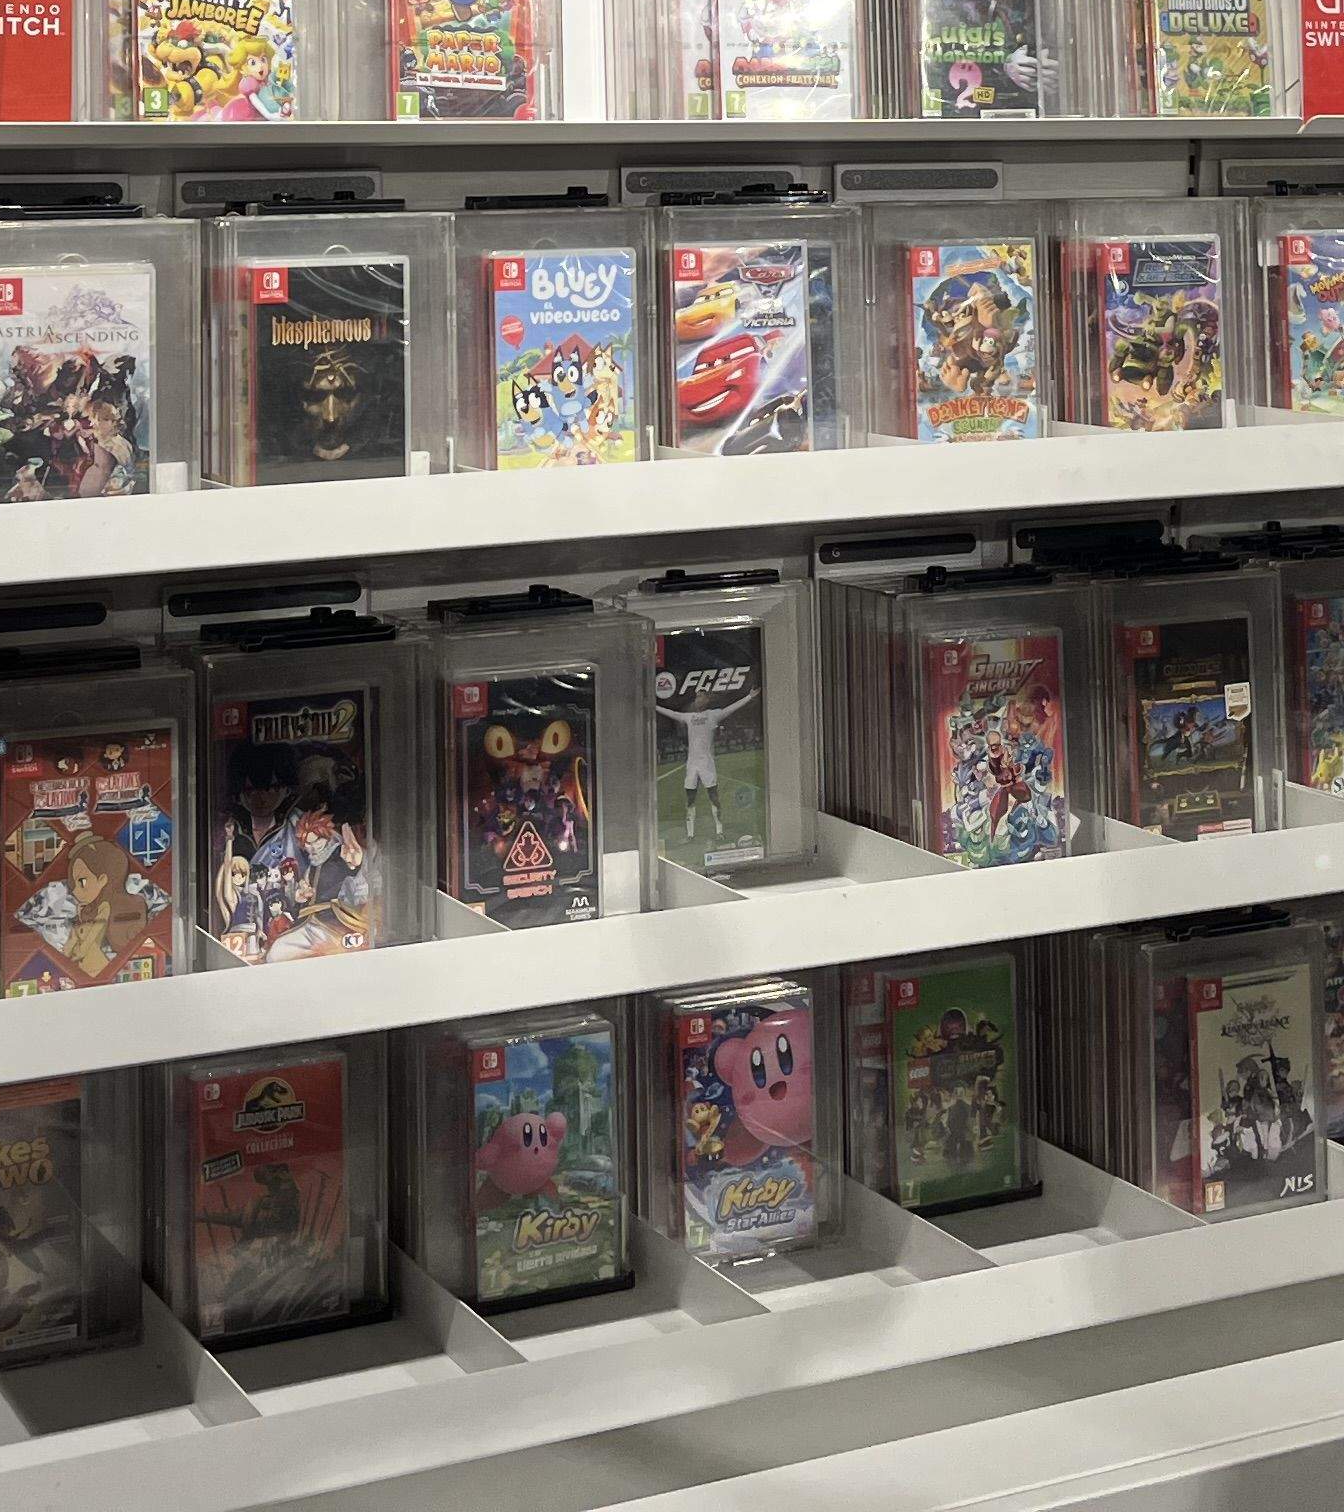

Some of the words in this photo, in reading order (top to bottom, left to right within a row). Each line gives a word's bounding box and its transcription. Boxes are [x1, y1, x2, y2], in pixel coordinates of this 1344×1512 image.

[1168, 11, 1251, 34] DELUXE
[427, 29, 501, 52] PAPER
[426, 51, 501, 76] MARIO
[150, 92, 162, 112] 3
[529, 306, 620, 327] VIDEOJUEGO
[43, 328, 139, 345] ASCENDING
[270, 314, 372, 350] blasphemous
[718, 1175, 796, 1220] Kirby
[514, 1210, 600, 1250] Kirby
